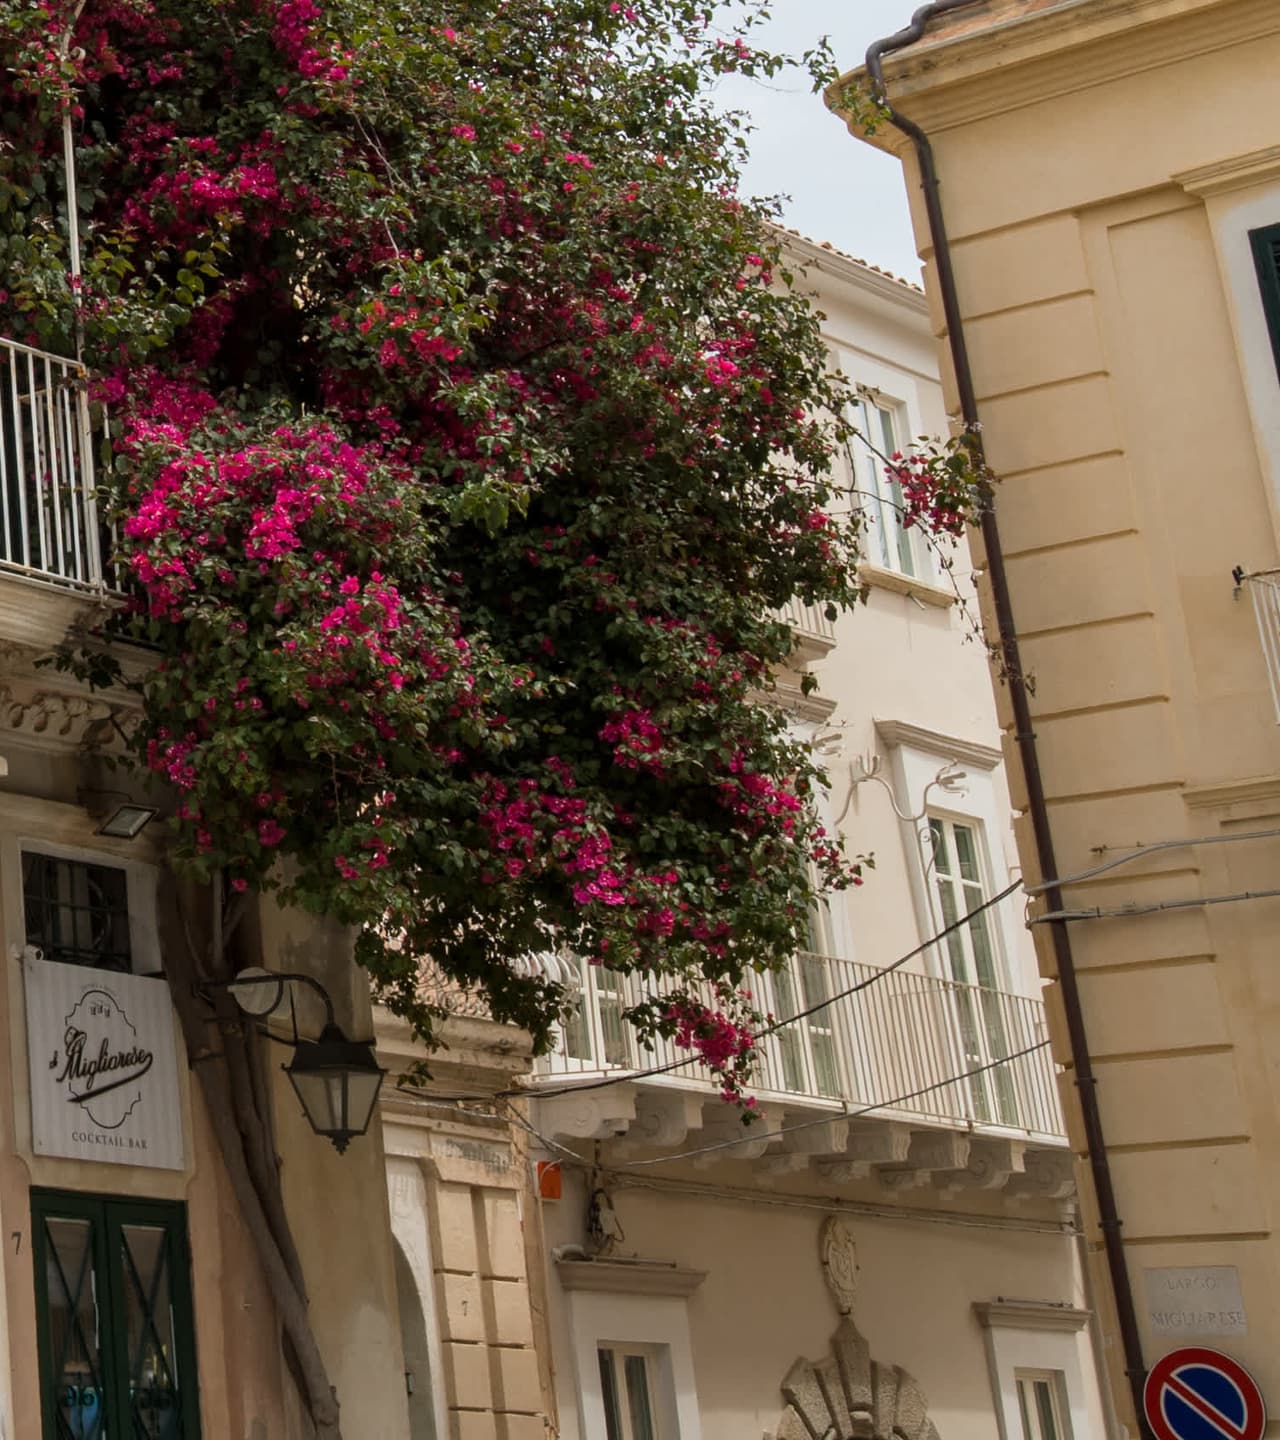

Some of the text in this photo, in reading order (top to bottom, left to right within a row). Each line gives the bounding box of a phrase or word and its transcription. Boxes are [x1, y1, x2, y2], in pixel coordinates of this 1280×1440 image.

[56, 1037, 153, 1090] Migliarese
[71, 1131, 148, 1150] COCKTAIL BAR
[11, 1232, 22, 1255] 7
